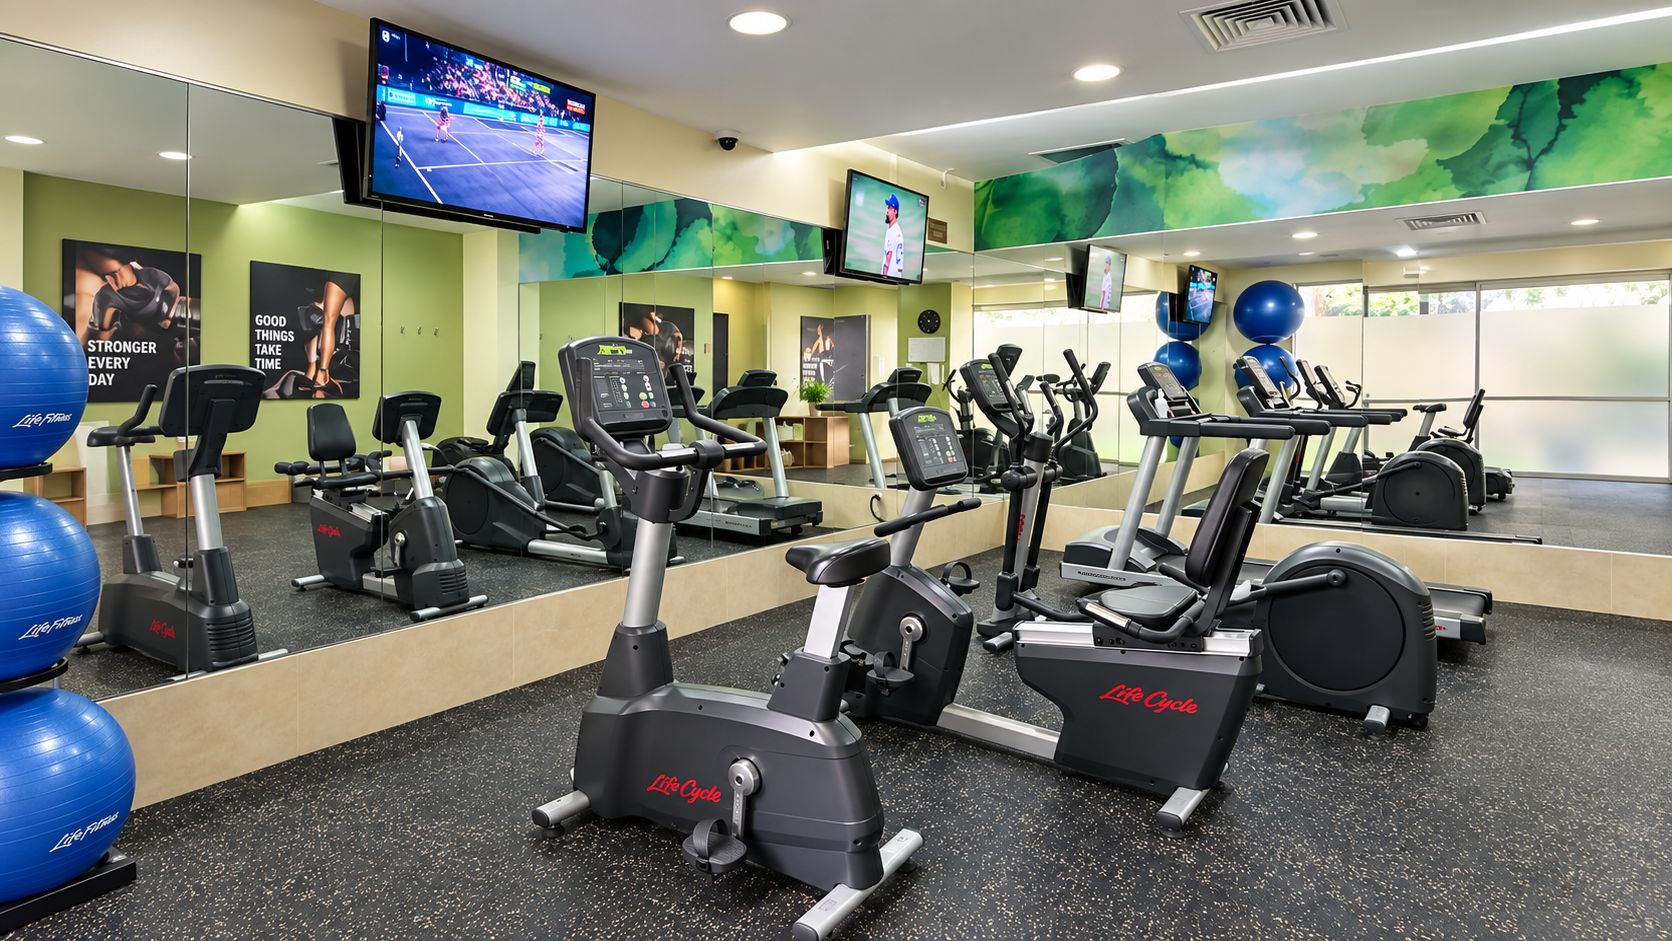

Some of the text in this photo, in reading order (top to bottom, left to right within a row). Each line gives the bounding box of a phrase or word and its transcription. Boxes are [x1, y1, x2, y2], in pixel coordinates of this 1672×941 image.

[255, 314, 287, 328] GOOD
[255, 328, 295, 343] THINGS
[87, 339, 157, 355] STRONGER
[255, 343, 282, 356] TAKE
[88, 356, 131, 370] EVERY
[255, 357, 281, 370] TIME
[88, 373, 115, 386] DAY
[12, 413, 45, 428] Life
[18, 621, 48, 640] Life
[1098, 683, 1198, 714] Life Cycle
[646, 773, 722, 804] Life Cycle
[49, 828, 83, 853] Life
